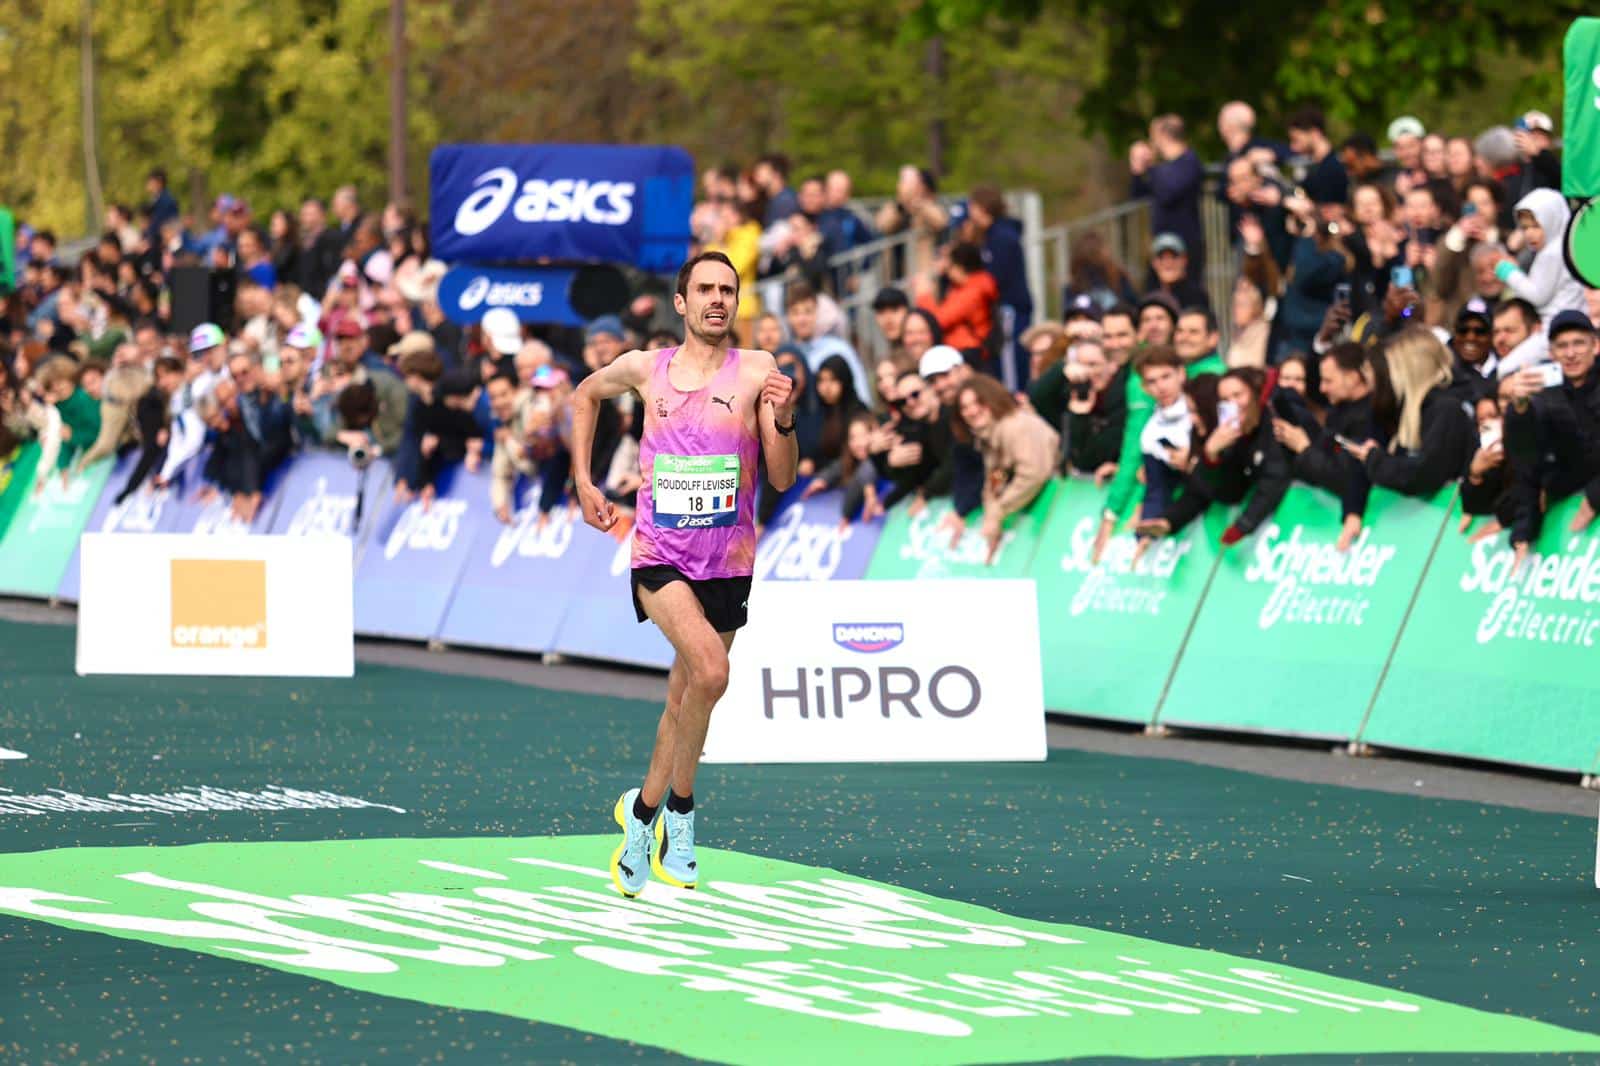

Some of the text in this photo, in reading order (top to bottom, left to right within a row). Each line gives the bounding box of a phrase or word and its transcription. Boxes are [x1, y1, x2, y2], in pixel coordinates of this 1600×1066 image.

[513, 179, 636, 225] asics
[486, 282, 543, 306] asics
[657, 478, 736, 491] ROUDOLFF LEVISSE
[688, 496, 704, 512] 18
[1504, 598, 1600, 647] Electric
[761, 664, 982, 720] HiPRO
